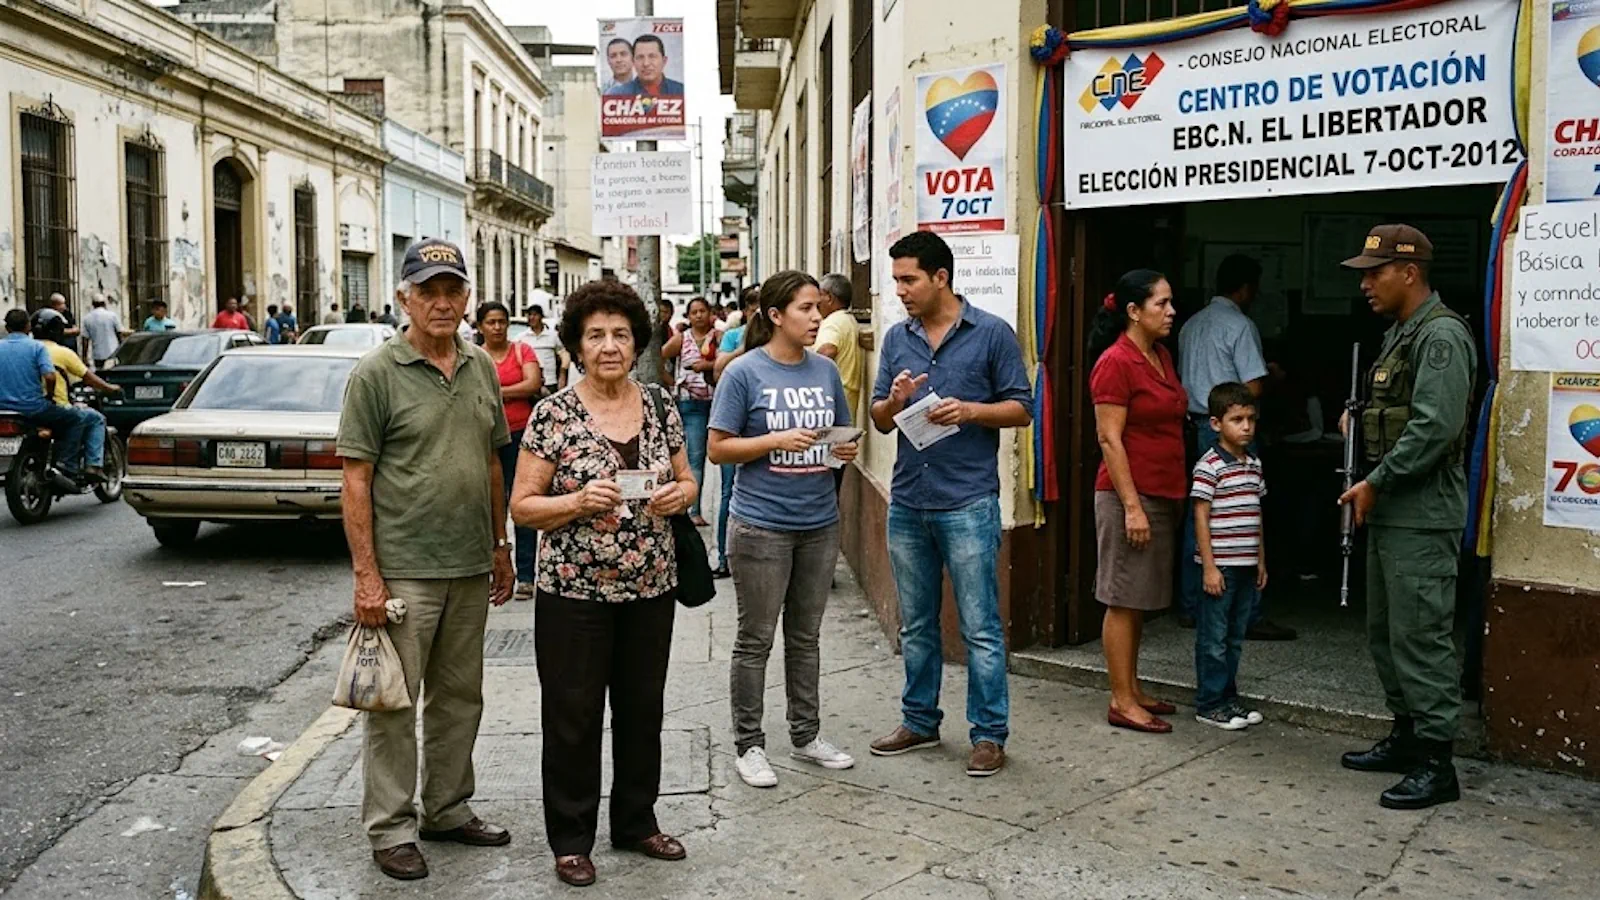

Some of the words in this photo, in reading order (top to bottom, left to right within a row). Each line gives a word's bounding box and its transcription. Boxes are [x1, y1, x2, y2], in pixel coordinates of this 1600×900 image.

[1188, 46, 1265, 70] CONSEJO
[1271, 33, 1362, 59] NACIONAL
[1368, 14, 1487, 46] ELECTORAL
[1178, 80, 1279, 114] CENTRO
[1289, 74, 1323, 102] DE
[1332, 50, 1486, 97] VOTACIÓN
[1173, 120, 1252, 151] EBC.N.
[1262, 116, 1292, 142] EL
[1303, 96, 1487, 139] LIBERTADOR
[1554, 118, 1600, 144] CH
[1079, 162, 1177, 194] ELECCIÓN
[1185, 152, 1355, 187] PRESIDENCIAL
[1364, 138, 1518, 175] 7-OCT-2012
[925, 167, 994, 196] VOTA
[942, 197, 954, 219] 7
[956, 197, 992, 216] OCT
[1525, 211, 1600, 241] Escuel
[1517, 249, 1585, 273] Básica
[763, 388, 778, 410] 7
[766, 410, 789, 430] MI
[792, 409, 835, 429] VOTO
